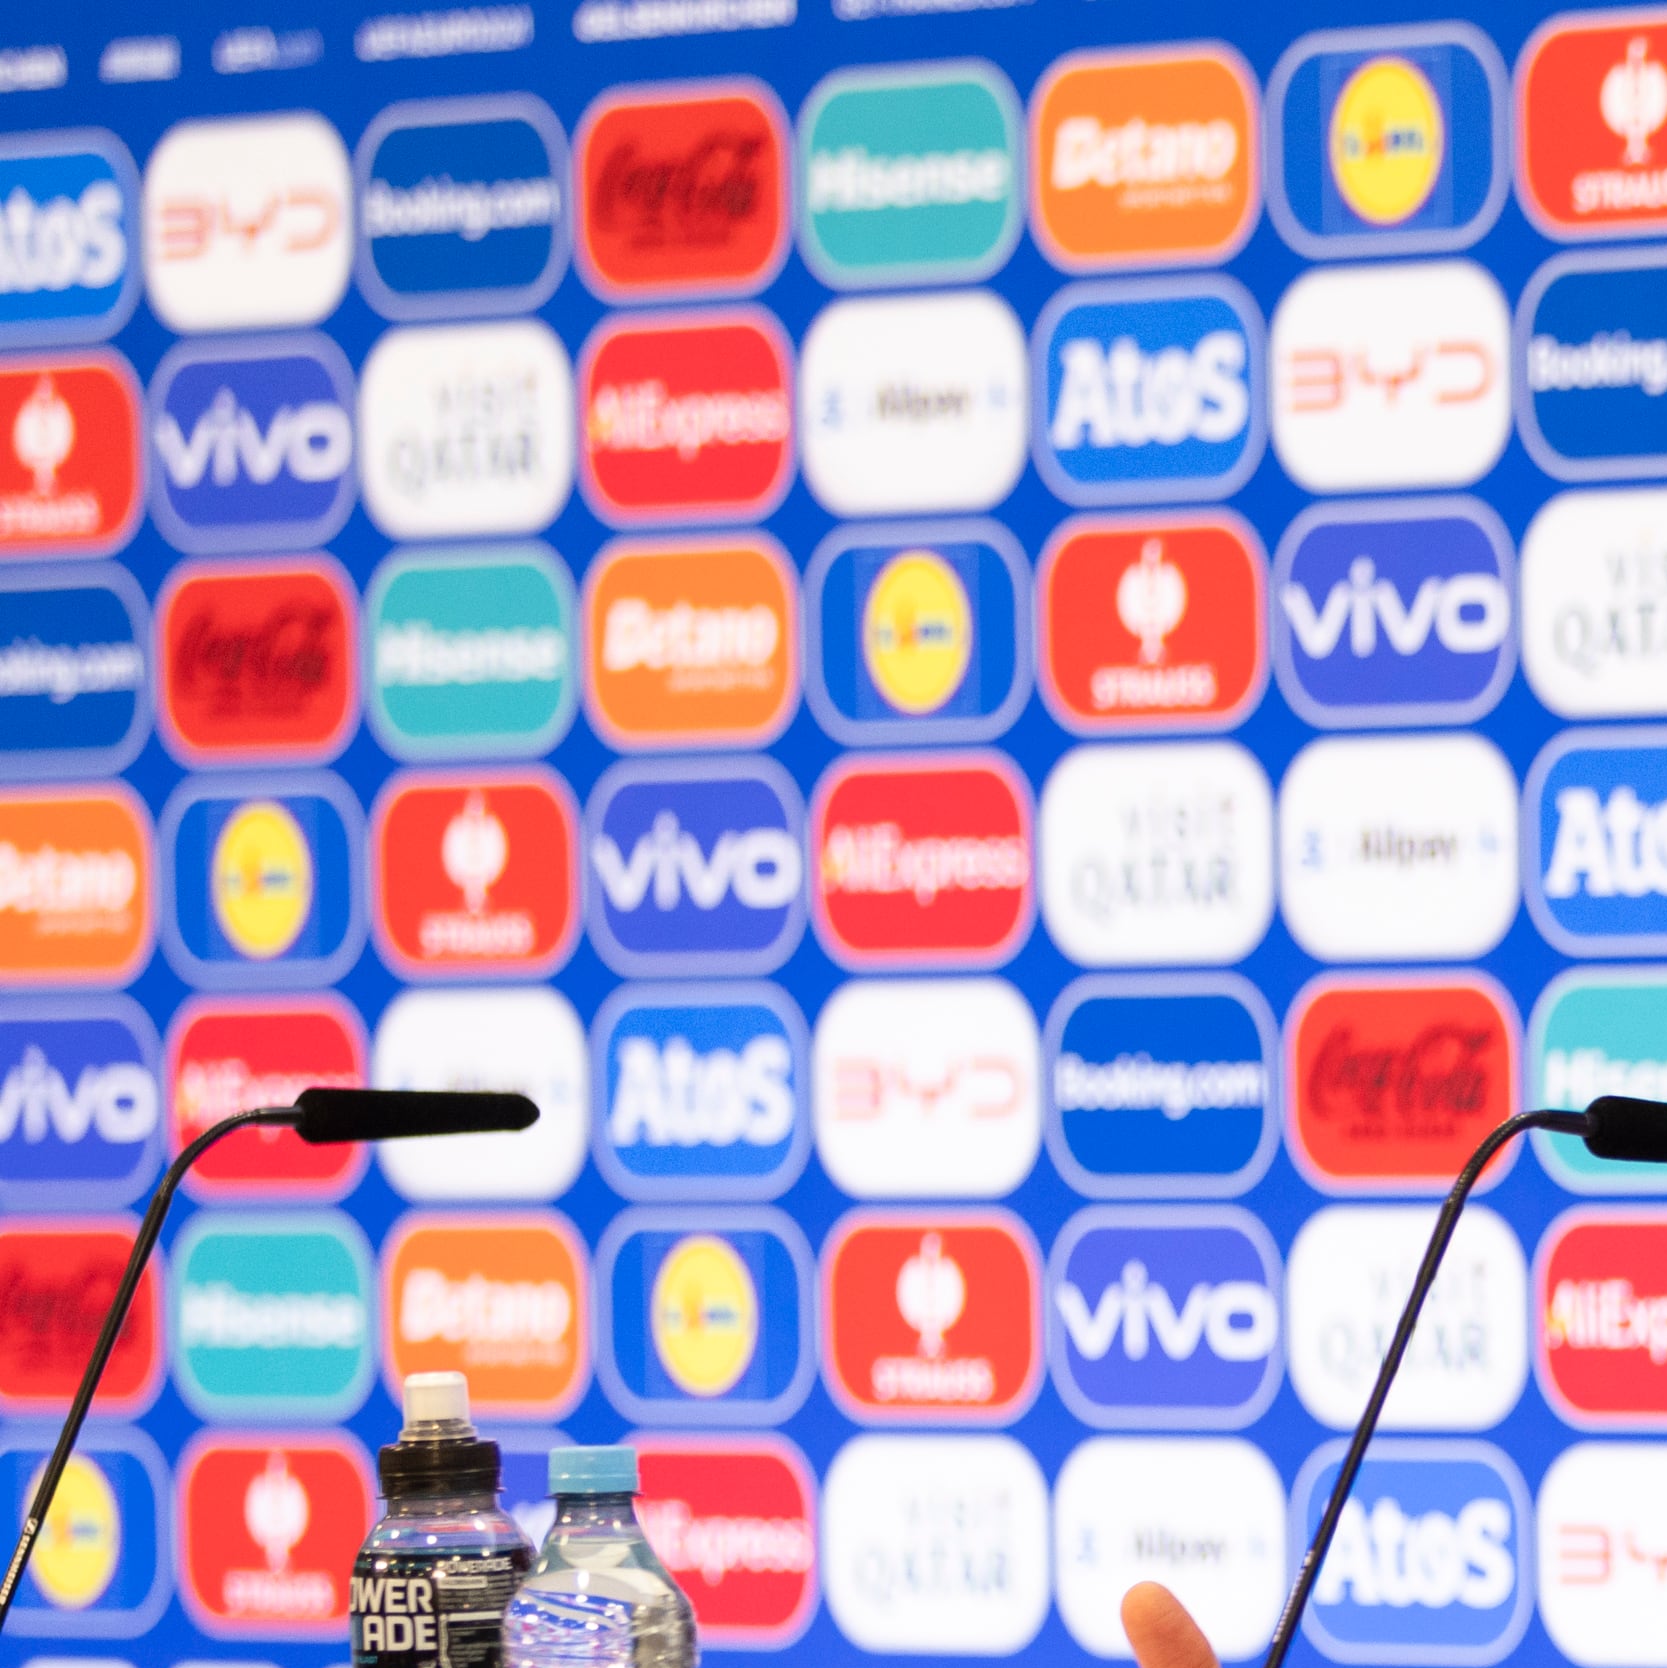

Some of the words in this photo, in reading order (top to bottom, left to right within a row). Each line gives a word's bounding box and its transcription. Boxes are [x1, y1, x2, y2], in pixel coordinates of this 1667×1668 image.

[146, 191, 341, 261] BYD
[1290, 340, 1496, 414] BYD
[156, 388, 352, 488] vivo
[1280, 554, 1511, 658] vivo
[591, 808, 802, 910] vivo
[1055, 1259, 1280, 1362] vivo
[362, 1615, 438, 1651] ADE
